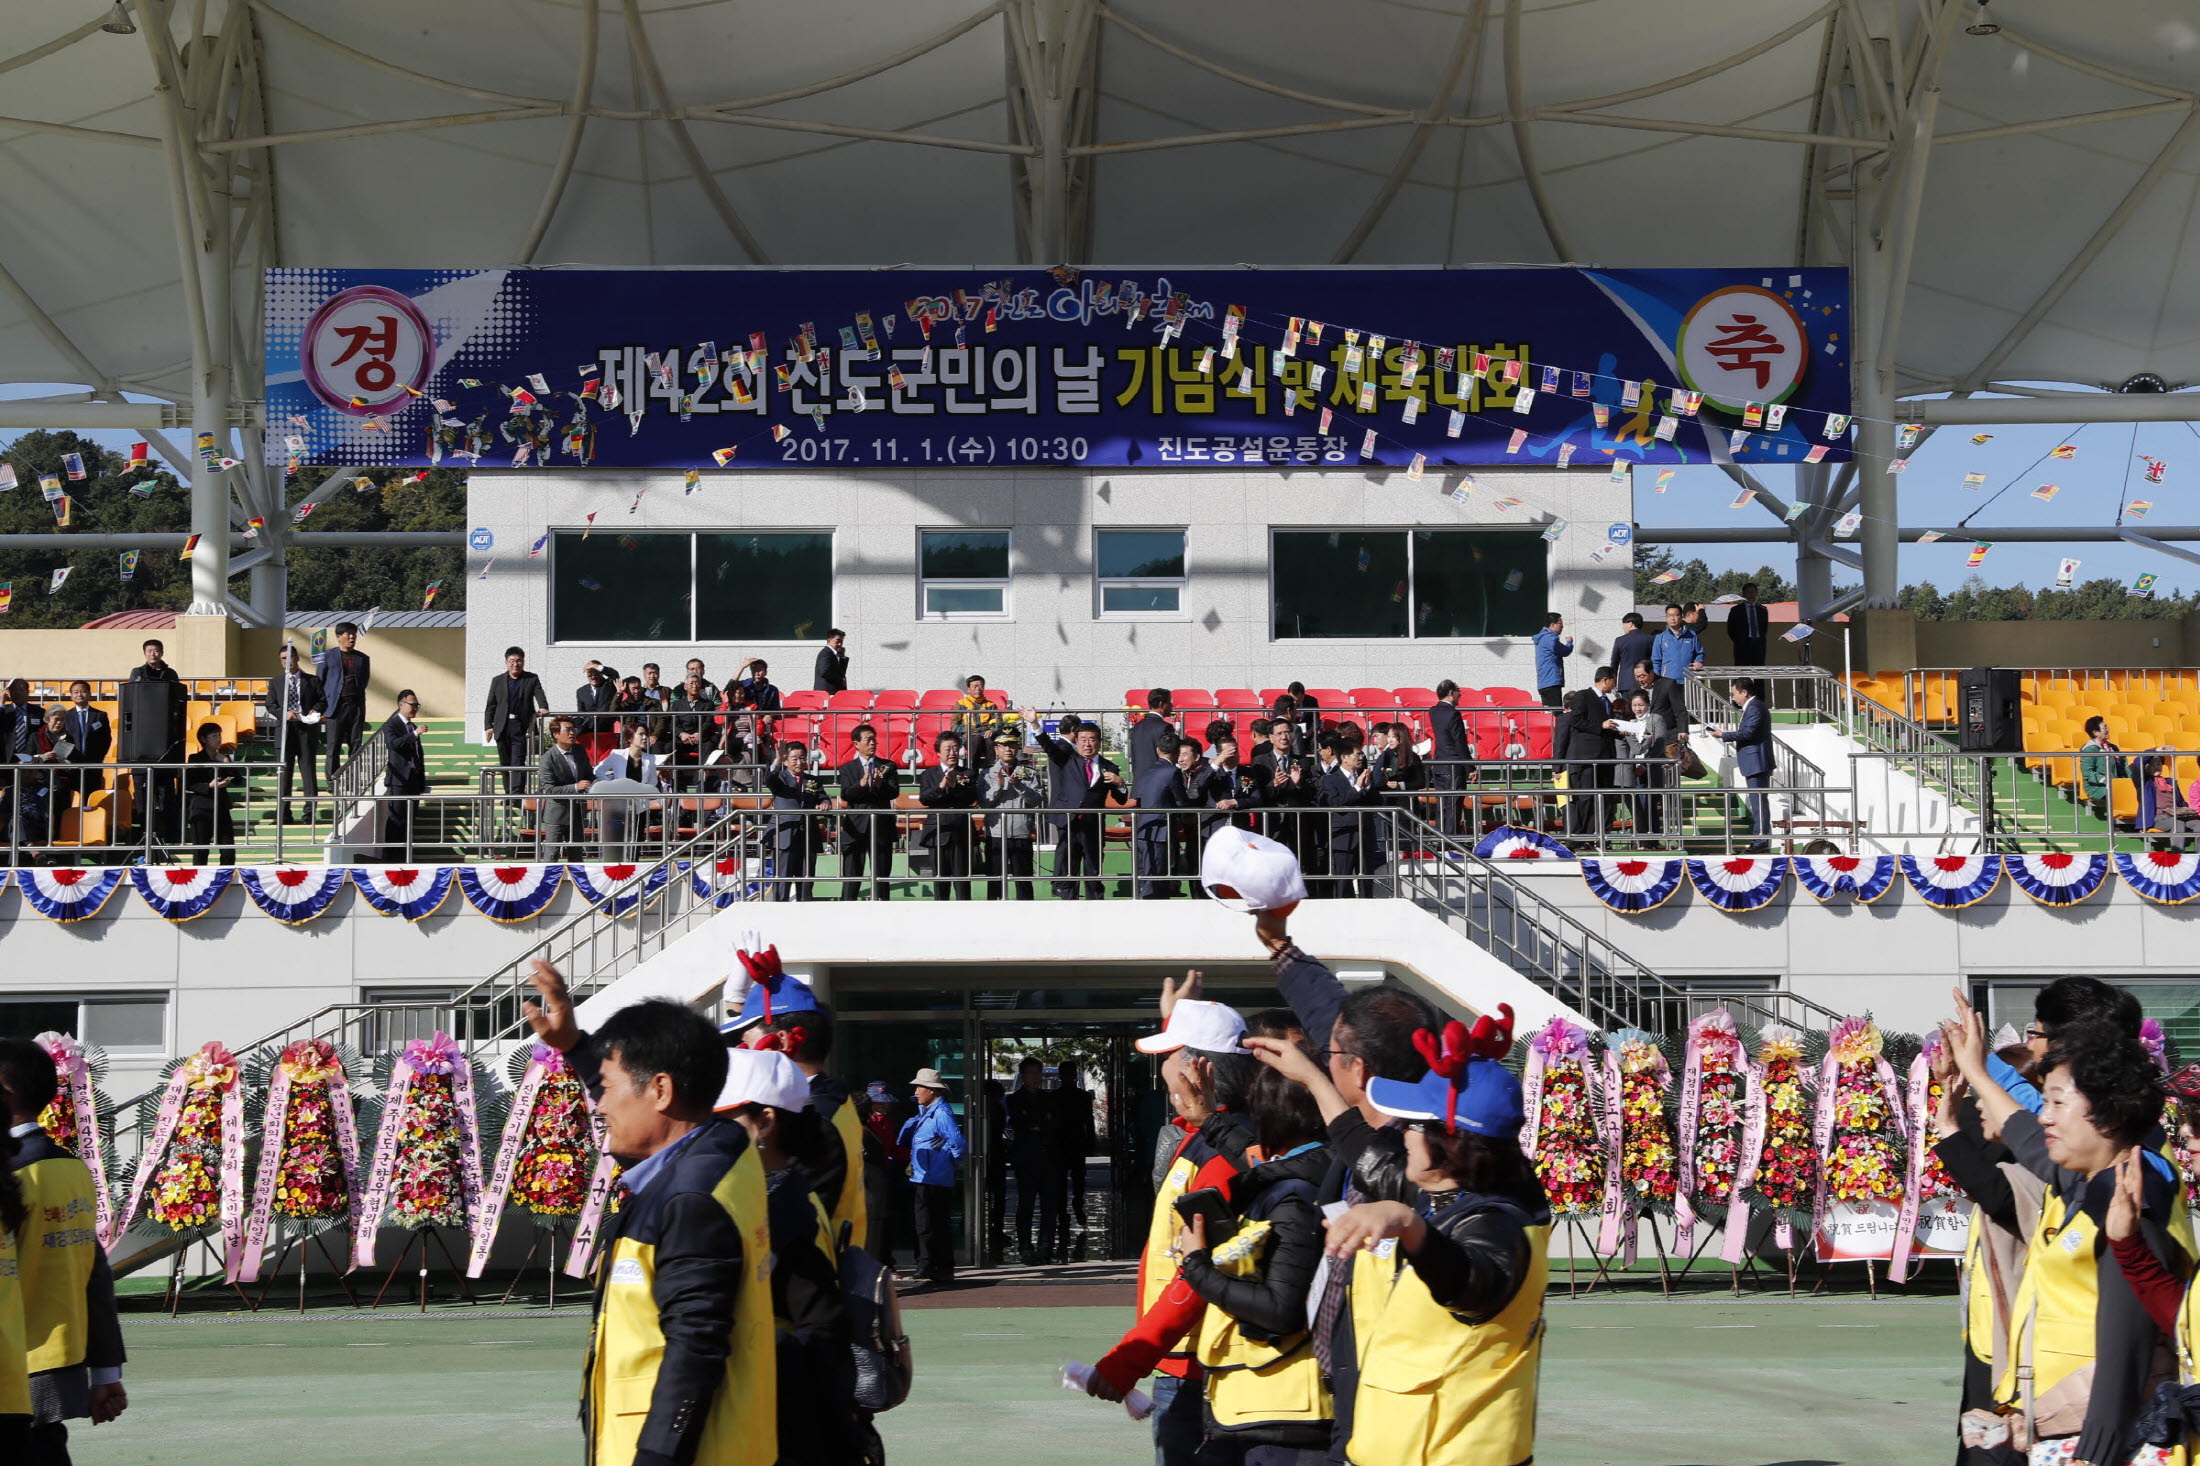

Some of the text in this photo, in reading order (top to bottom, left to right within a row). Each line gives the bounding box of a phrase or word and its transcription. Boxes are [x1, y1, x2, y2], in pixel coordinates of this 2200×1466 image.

[331, 316, 398, 391] 경
[1705, 314, 1785, 389] 축
[598, 343, 1529, 415] 제42회 진도군민의 날 기념식 및 체육대회
[782, 438, 859, 461] 2017.
[871, 438, 908, 461] 11.
[1007, 437, 1088, 461] 10:30
[1158, 436, 1348, 462] 진도공설운동장
[473, 536, 489, 544] ADT
[1612, 529, 1628, 538] ADT
[79, 1115, 95, 1160] 제42회
